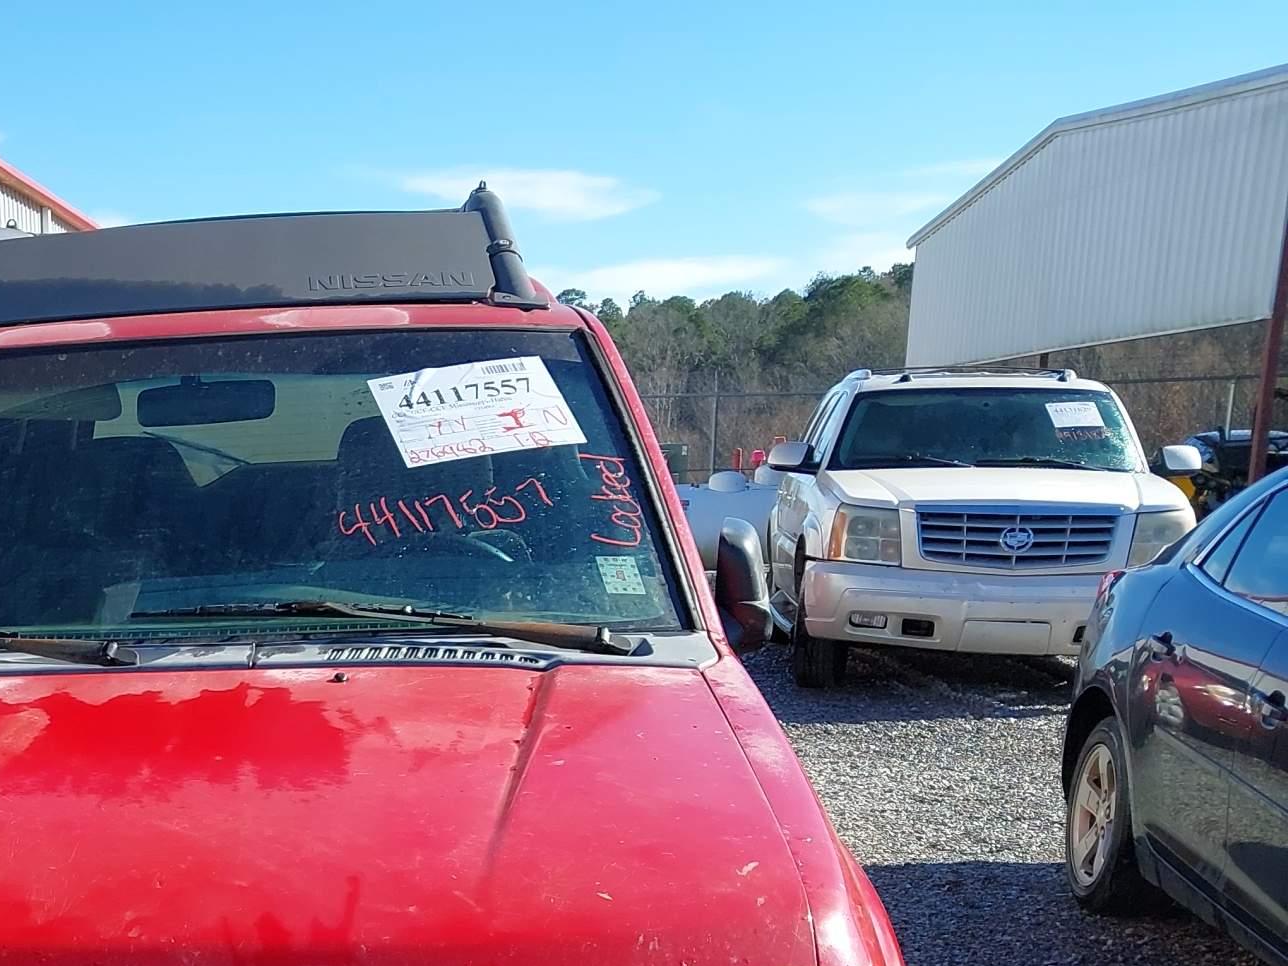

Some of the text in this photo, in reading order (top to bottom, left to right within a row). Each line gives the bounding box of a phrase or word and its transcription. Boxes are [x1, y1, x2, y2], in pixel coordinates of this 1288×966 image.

[308, 271, 475, 291] NISSAN
[399, 377, 530, 409] 44117557
[338, 477, 554, 546] 44117557
[578, 453, 643, 546] Locked
